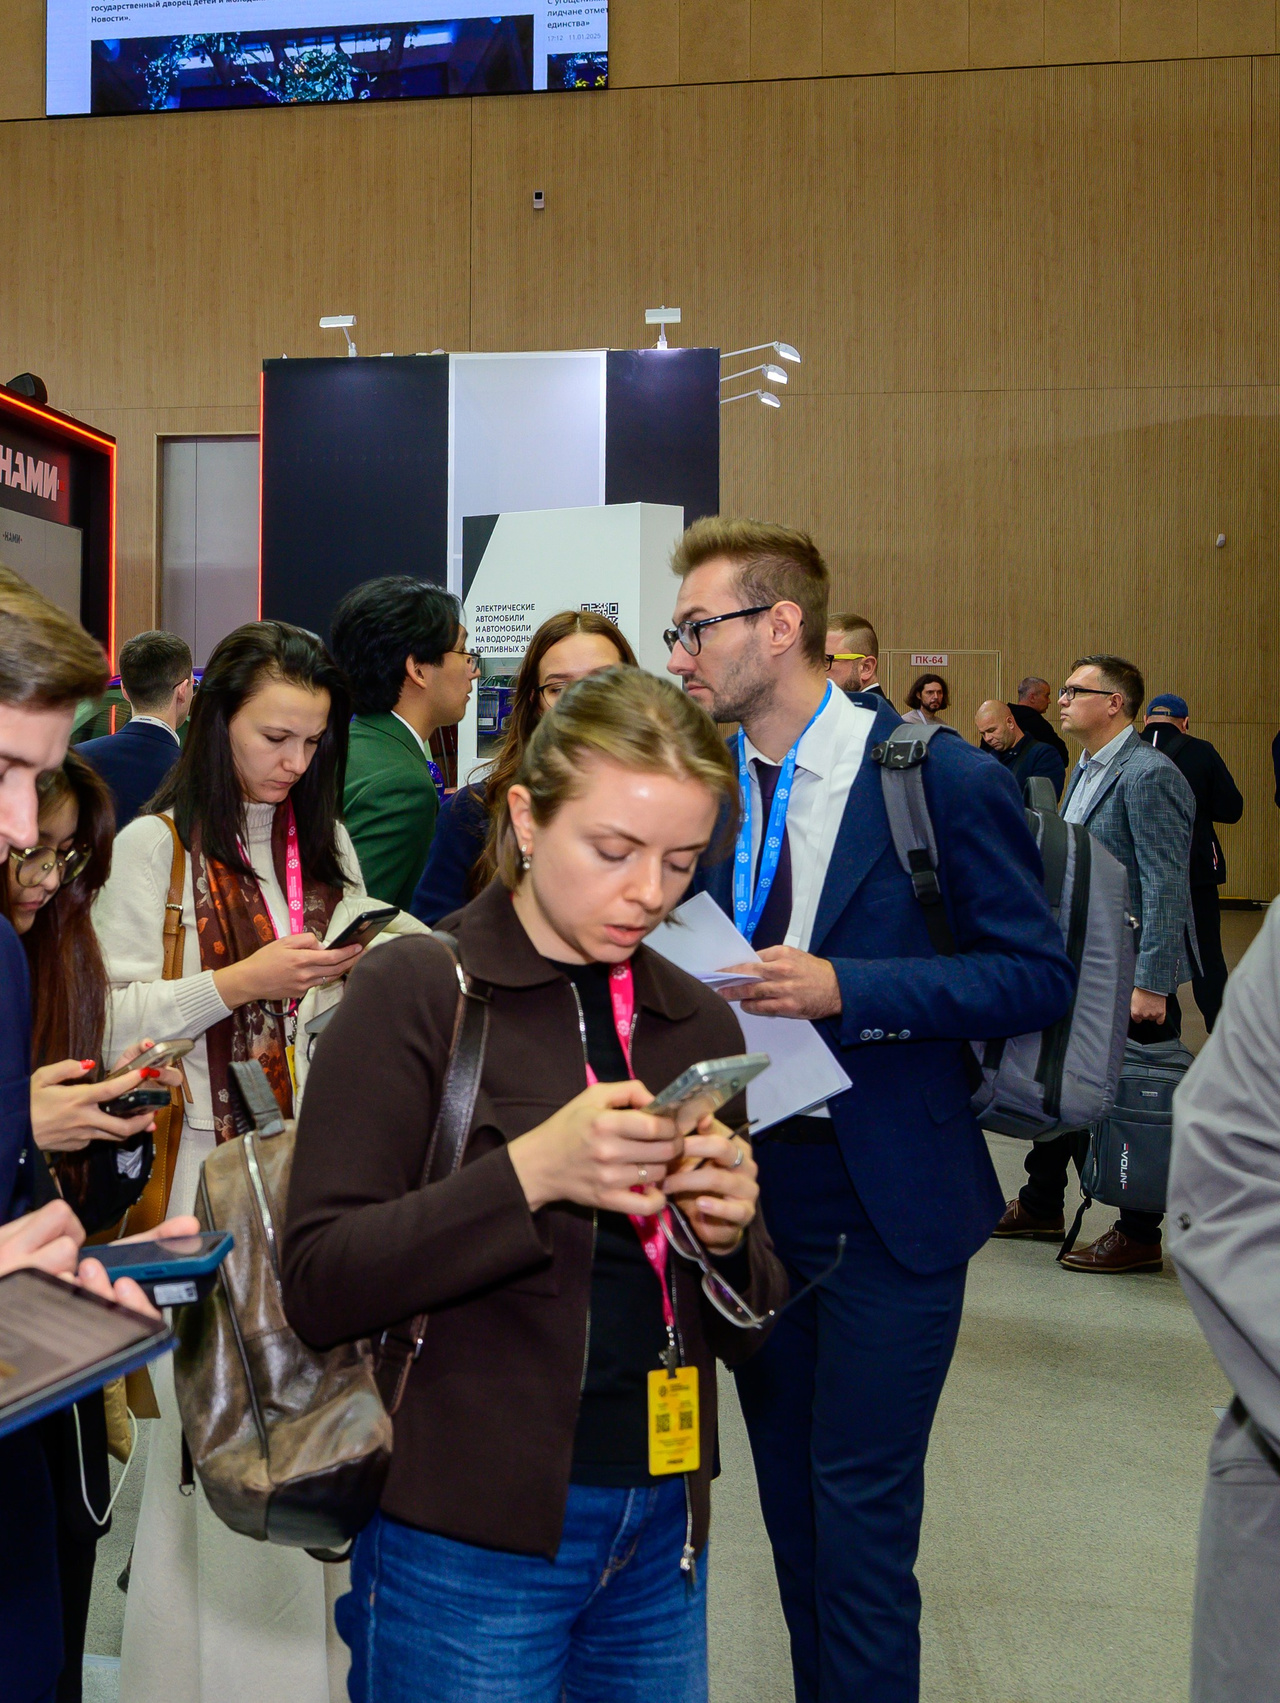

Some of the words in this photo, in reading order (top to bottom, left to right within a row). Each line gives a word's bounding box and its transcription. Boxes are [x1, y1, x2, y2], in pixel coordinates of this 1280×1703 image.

[91, 1, 160, 12] государственный
[547, 9, 582, 17] лидчане
[91, 15, 130, 23] Новости».
[547, 21, 590, 29] единства»
[4, 531, 21, 544] НАМИ
[475, 603, 536, 612] ЭЛЕКТРИЧЕСКИЕ
[475, 614, 525, 622] АВТОМОБИЛИ
[915, 655, 943, 664] ПК-64
